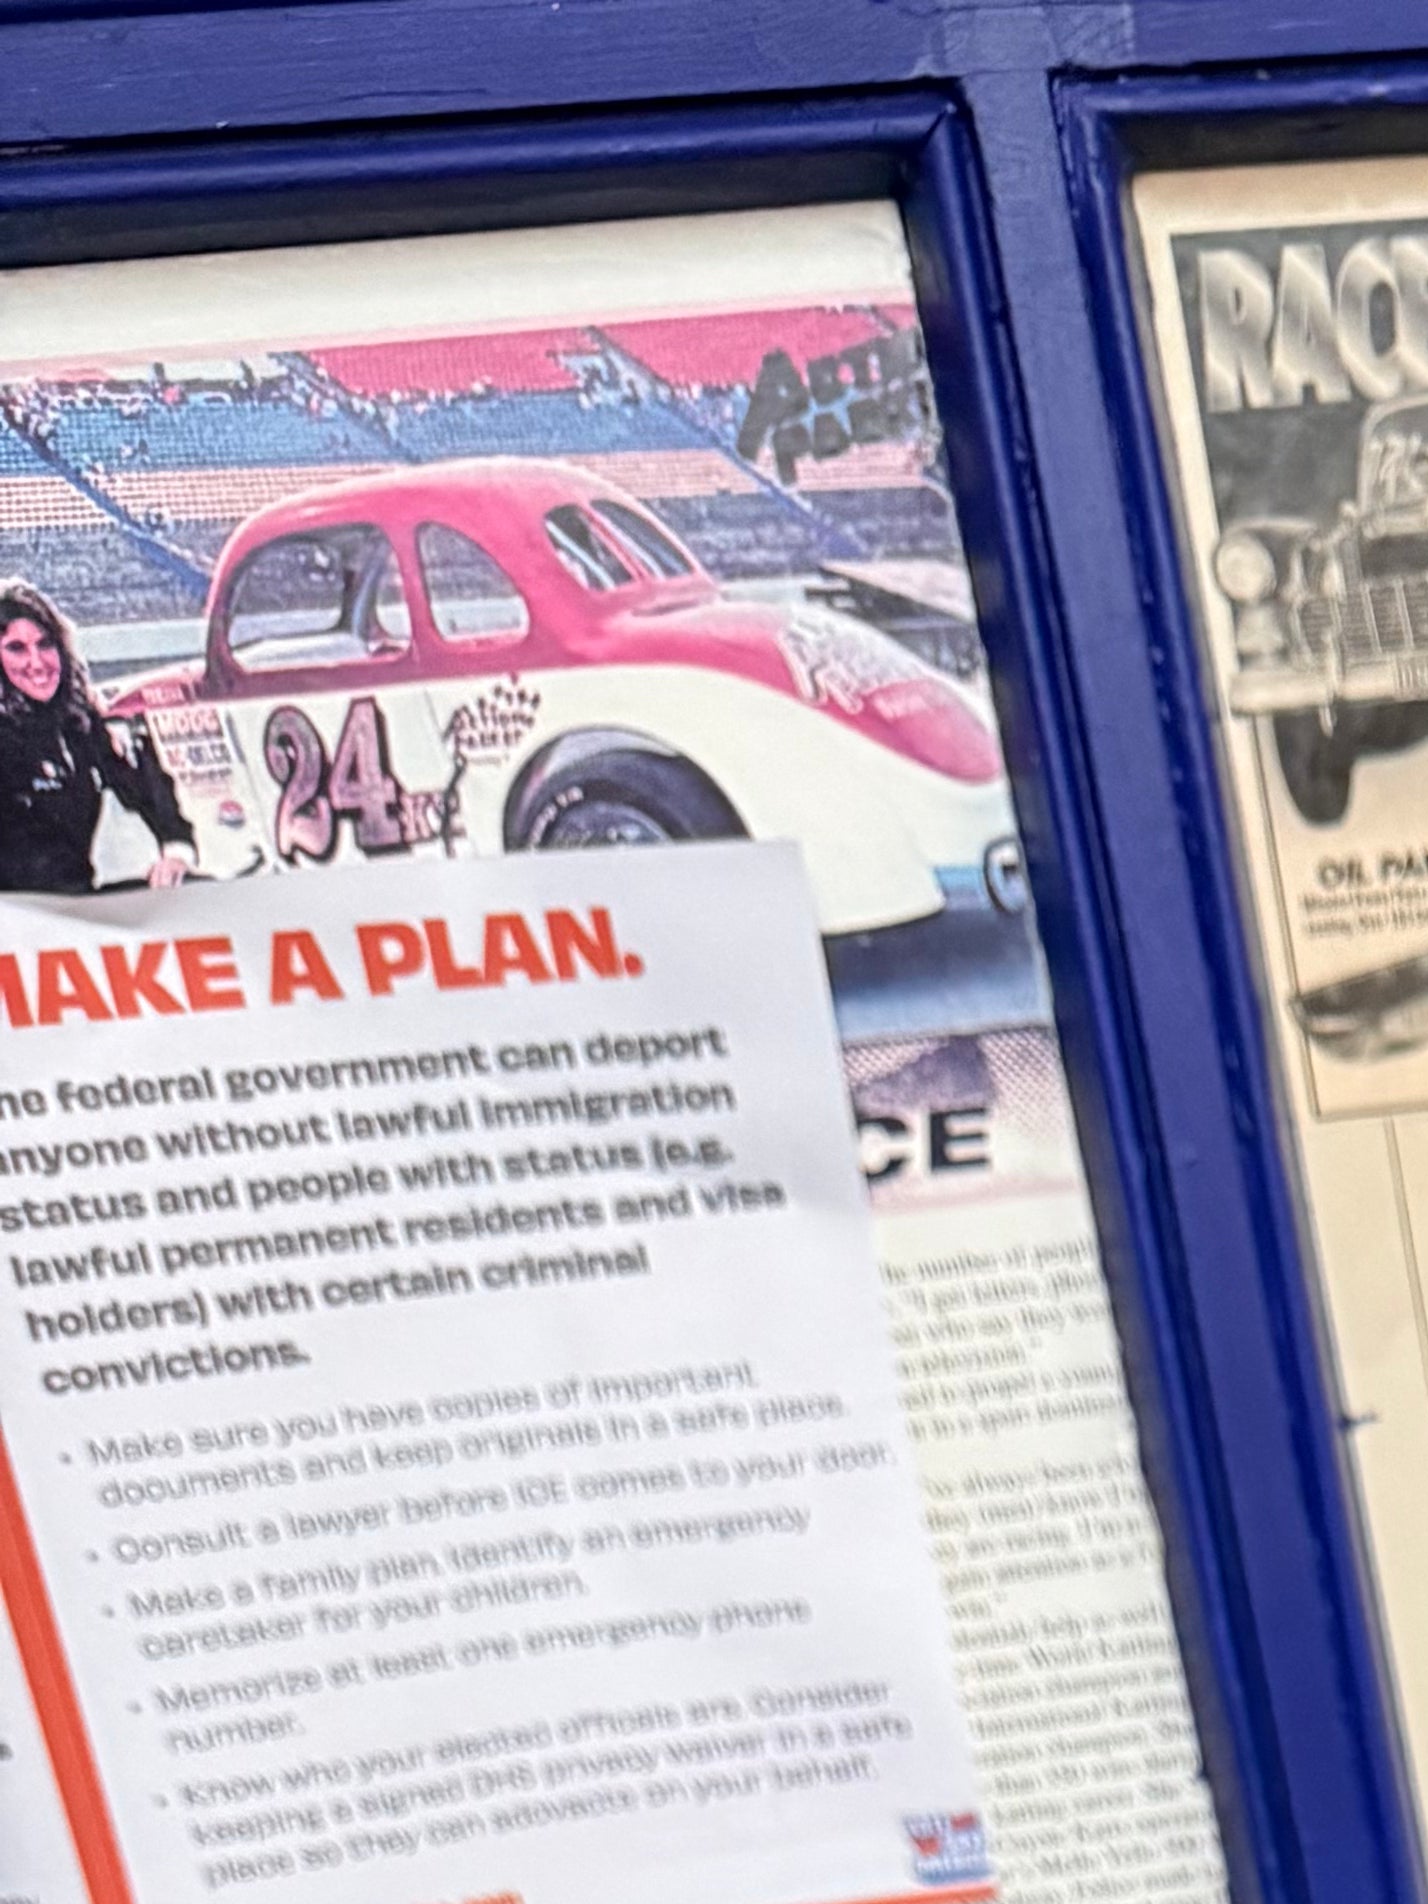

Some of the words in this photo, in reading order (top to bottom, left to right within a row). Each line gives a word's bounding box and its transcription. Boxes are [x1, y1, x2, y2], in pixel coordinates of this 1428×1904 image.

[264, 694, 412, 868] 24
[1316, 853, 1367, 889] OIL
[270, 928, 345, 1007] A
[355, 904, 646, 996] PLAN.
[57, 1068, 217, 1112] federal
[226, 1042, 490, 1101] government
[498, 1038, 577, 1073] can
[583, 1025, 729, 1068] deport
[156, 1112, 331, 1158] without
[338, 1098, 470, 1142] lawful
[478, 1080, 737, 1129] immigration
[1, 1191, 147, 1233] status
[157, 1177, 237, 1215] and
[246, 1164, 391, 1210] people
[398, 1151, 496, 1191] with
[501, 1141, 645, 1182] status
[10, 1243, 154, 1289] lawful
[159, 1217, 396, 1275] permanent
[402, 1200, 606, 1245] residents
[613, 1185, 693, 1222] and
[697, 1179, 789, 1213] visa
[25, 1289, 210, 1341] holders)
[215, 1281, 317, 1320] with
[321, 1264, 475, 1302] certain
[478, 1242, 652, 1289] criminal
[42, 1338, 311, 1394] convictions.
[85, 1431, 184, 1466] Make
[189, 1420, 270, 1455] sure
[274, 1411, 341, 1447] you
[344, 1399, 427, 1435] have
[99, 1459, 297, 1508] documents
[301, 1447, 368, 1481] and
[373, 1436, 454, 1471] keep
[111, 1522, 248, 1563] Consult
[257, 1518, 281, 1545] a
[285, 1502, 391, 1540] lawyer
[127, 1583, 227, 1620] Make
